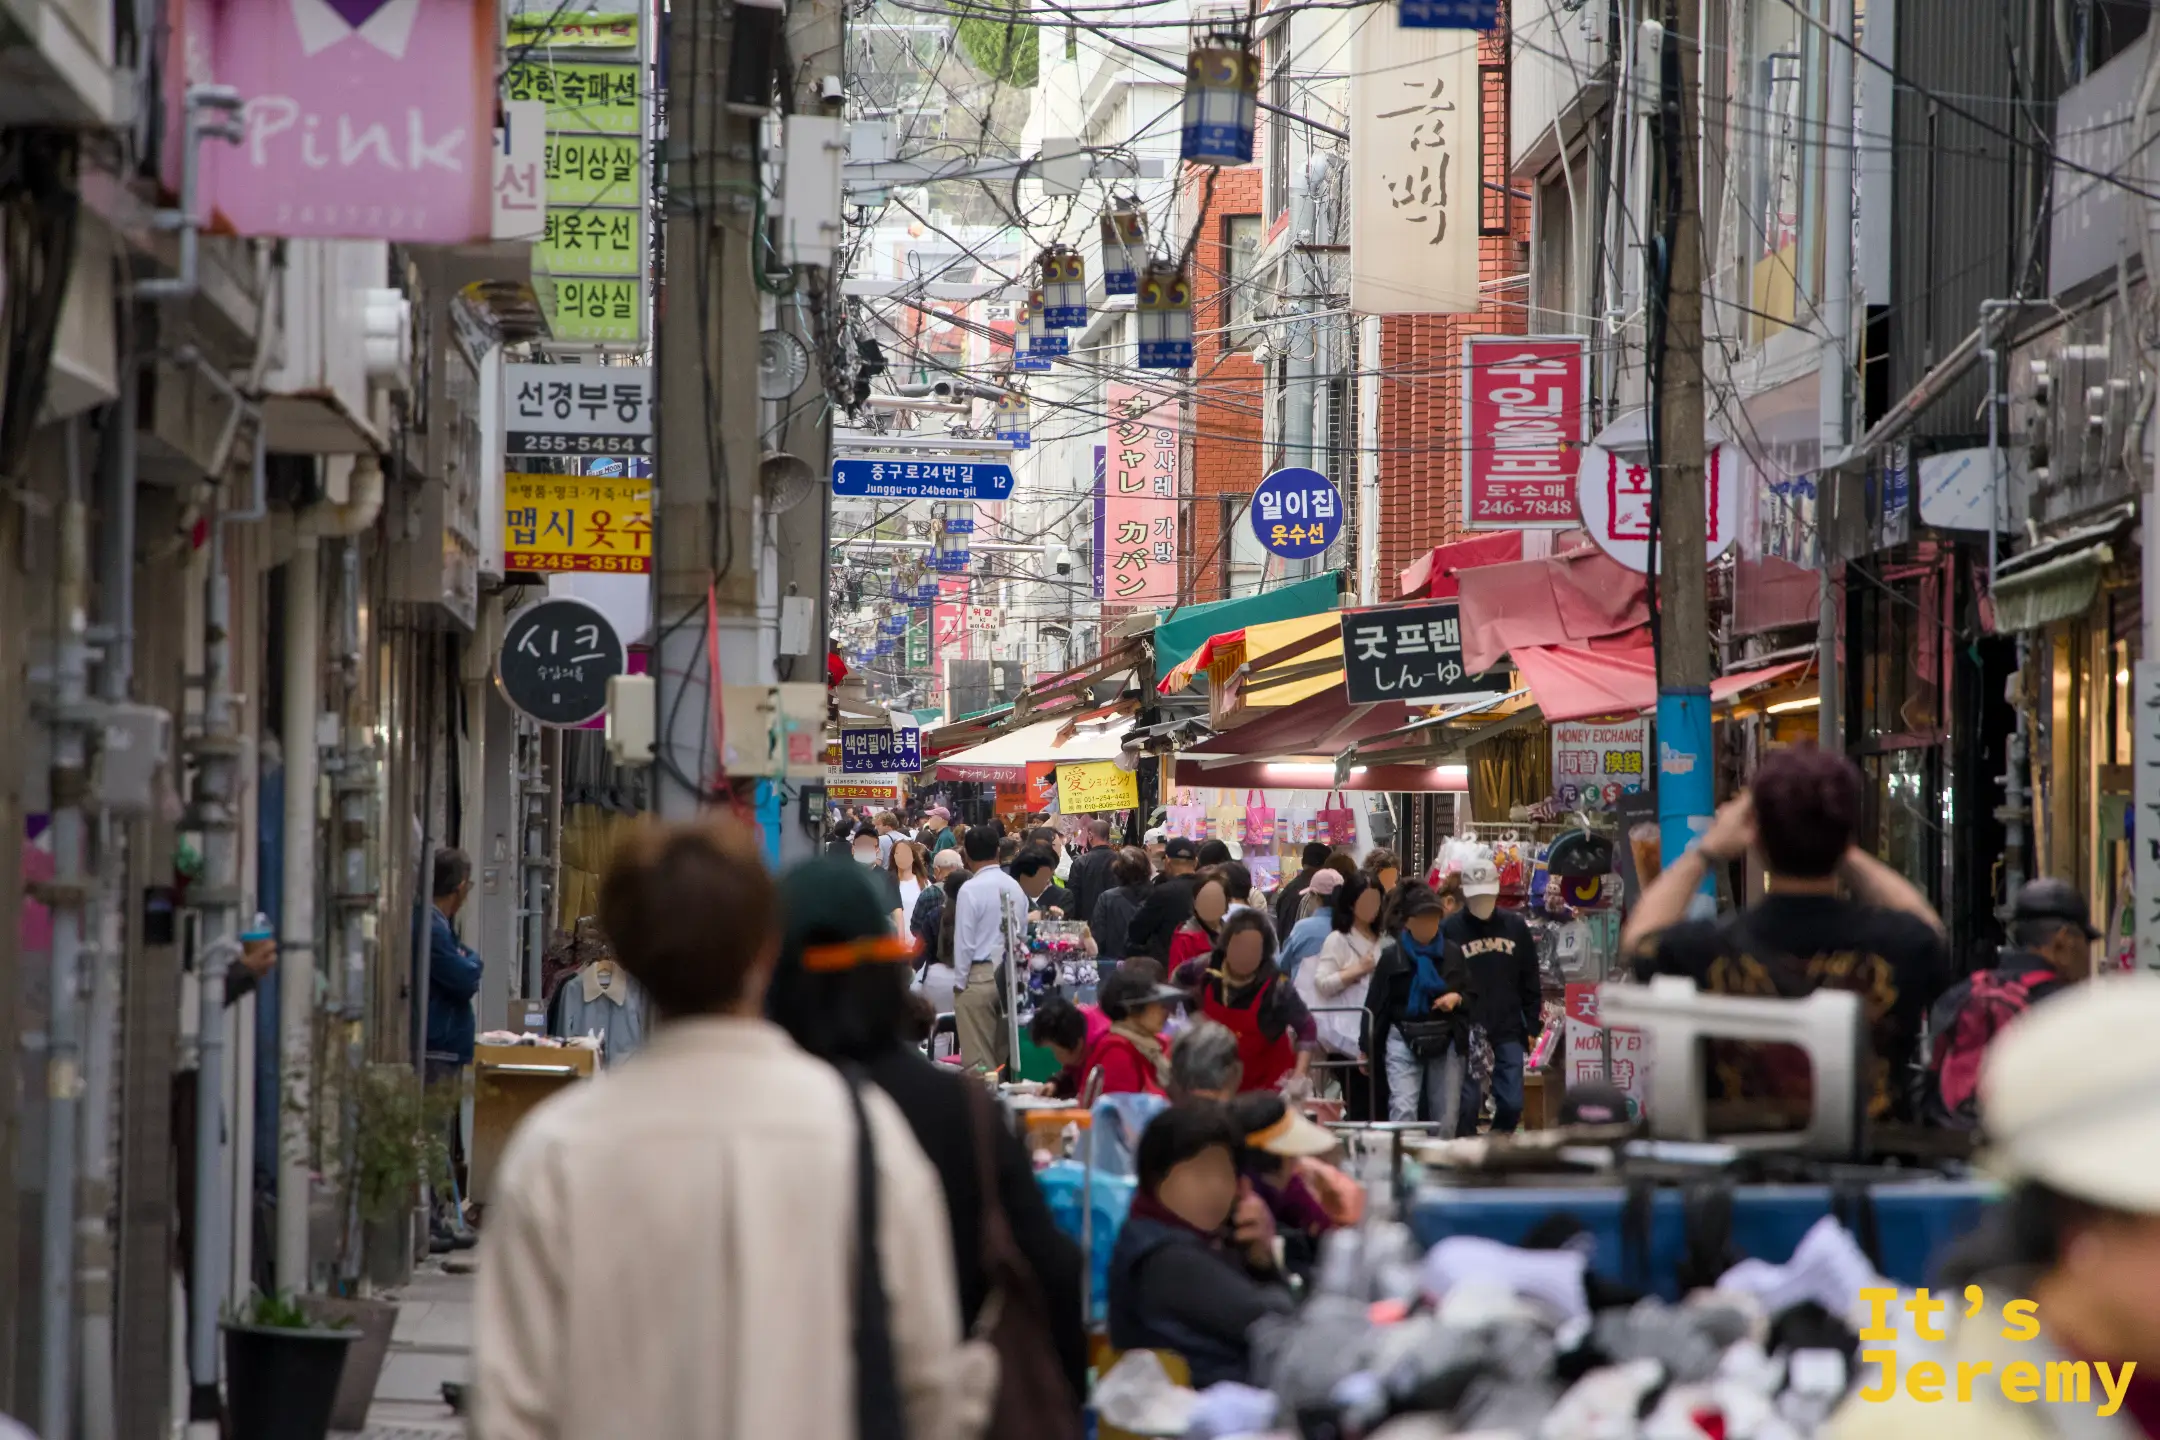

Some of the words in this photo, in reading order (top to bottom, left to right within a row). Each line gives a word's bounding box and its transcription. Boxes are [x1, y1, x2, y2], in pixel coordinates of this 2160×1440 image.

[510, 70, 635, 107] 강현숙패션
[243, 95, 466, 173] Pink
[517, 381, 653, 423] 선경부동
[524, 436, 635, 452] 255-5454
[1116, 396, 1150, 494] オシャレ
[837, 472, 846, 484] 8
[1154, 429, 1176, 497] 오샤레
[864, 483, 917, 495] Junggu-ro
[920, 484, 977, 498] 24beon-gil
[992, 477, 1006, 489] 12
[1259, 489, 1334, 520] 일이집
[1478, 500, 1572, 515] 246-7848
[507, 507, 574, 547] 맵시
[1153, 518, 1175, 564] 가방
[1271, 523, 1325, 547] 옷수선
[532, 555, 644, 571] 245-3518
[1112, 521, 1149, 596] カバン
[517, 624, 606, 663] 시크
[1354, 625, 1388, 661] 굿
[1374, 660, 1484, 691] しん-ゆ
[845, 731, 918, 756] 색연필아동복
[1557, 728, 1590, 743] MONEY
[1593, 728, 1644, 743] EXCHANGE
[846, 760, 873, 769] こども
[880, 758, 918, 769] せんもん
[827, 787, 867, 797] 세브란스
[871, 788, 892, 797] 안경
